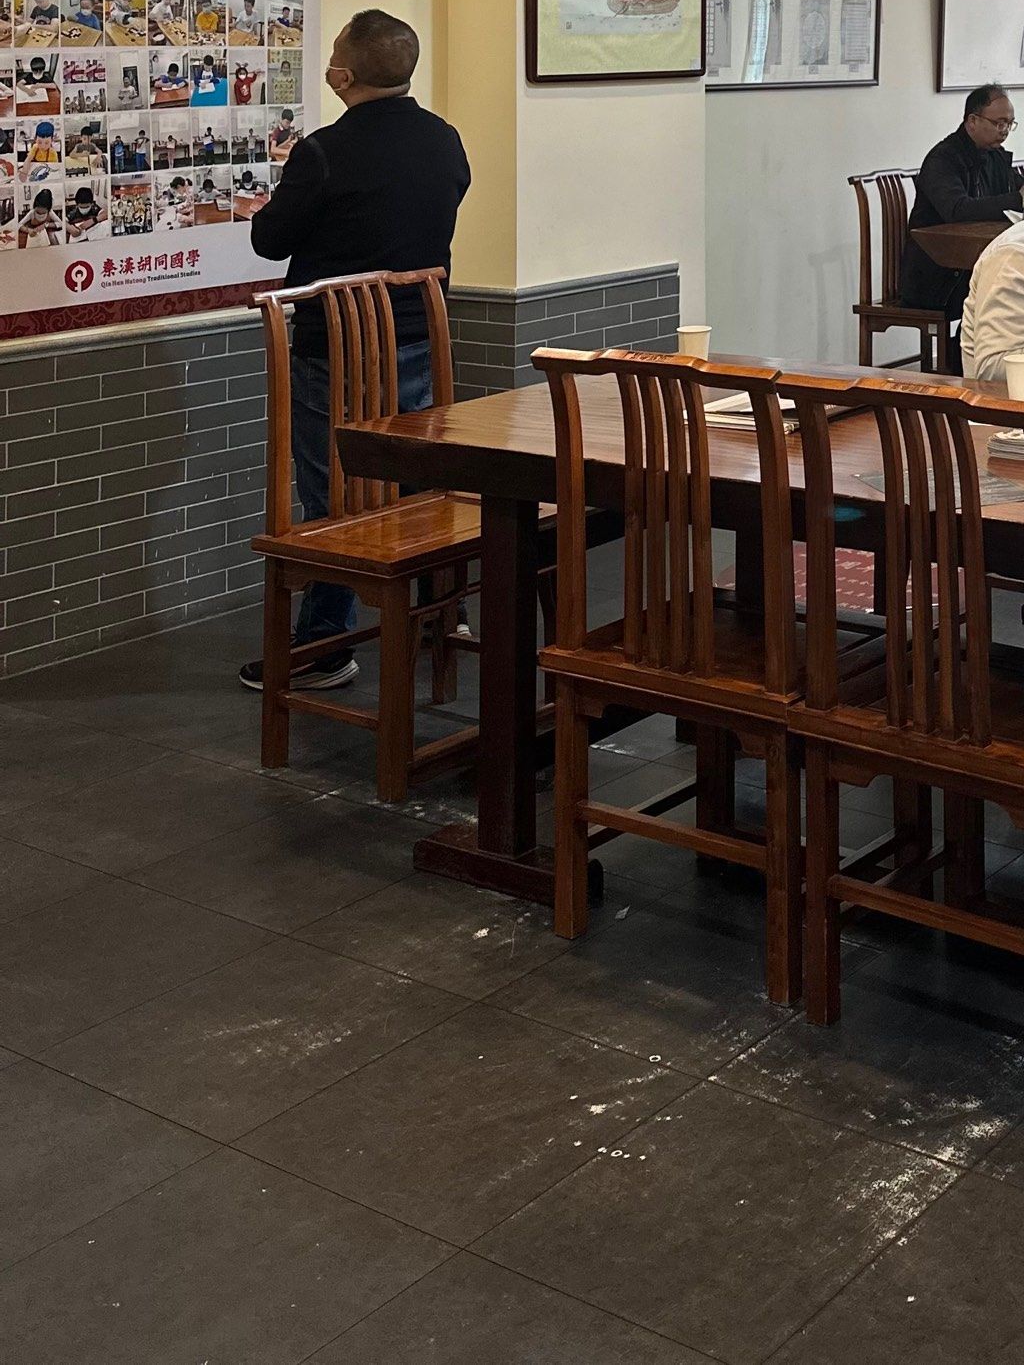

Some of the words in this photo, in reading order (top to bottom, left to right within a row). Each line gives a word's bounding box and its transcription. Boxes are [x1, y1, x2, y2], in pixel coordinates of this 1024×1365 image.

[101, 248, 201, 278] 秦漢胡同國學
[112, 279, 124, 287] Han
[125, 276, 147, 285] Hutong
[147, 272, 180, 282] Traditional
